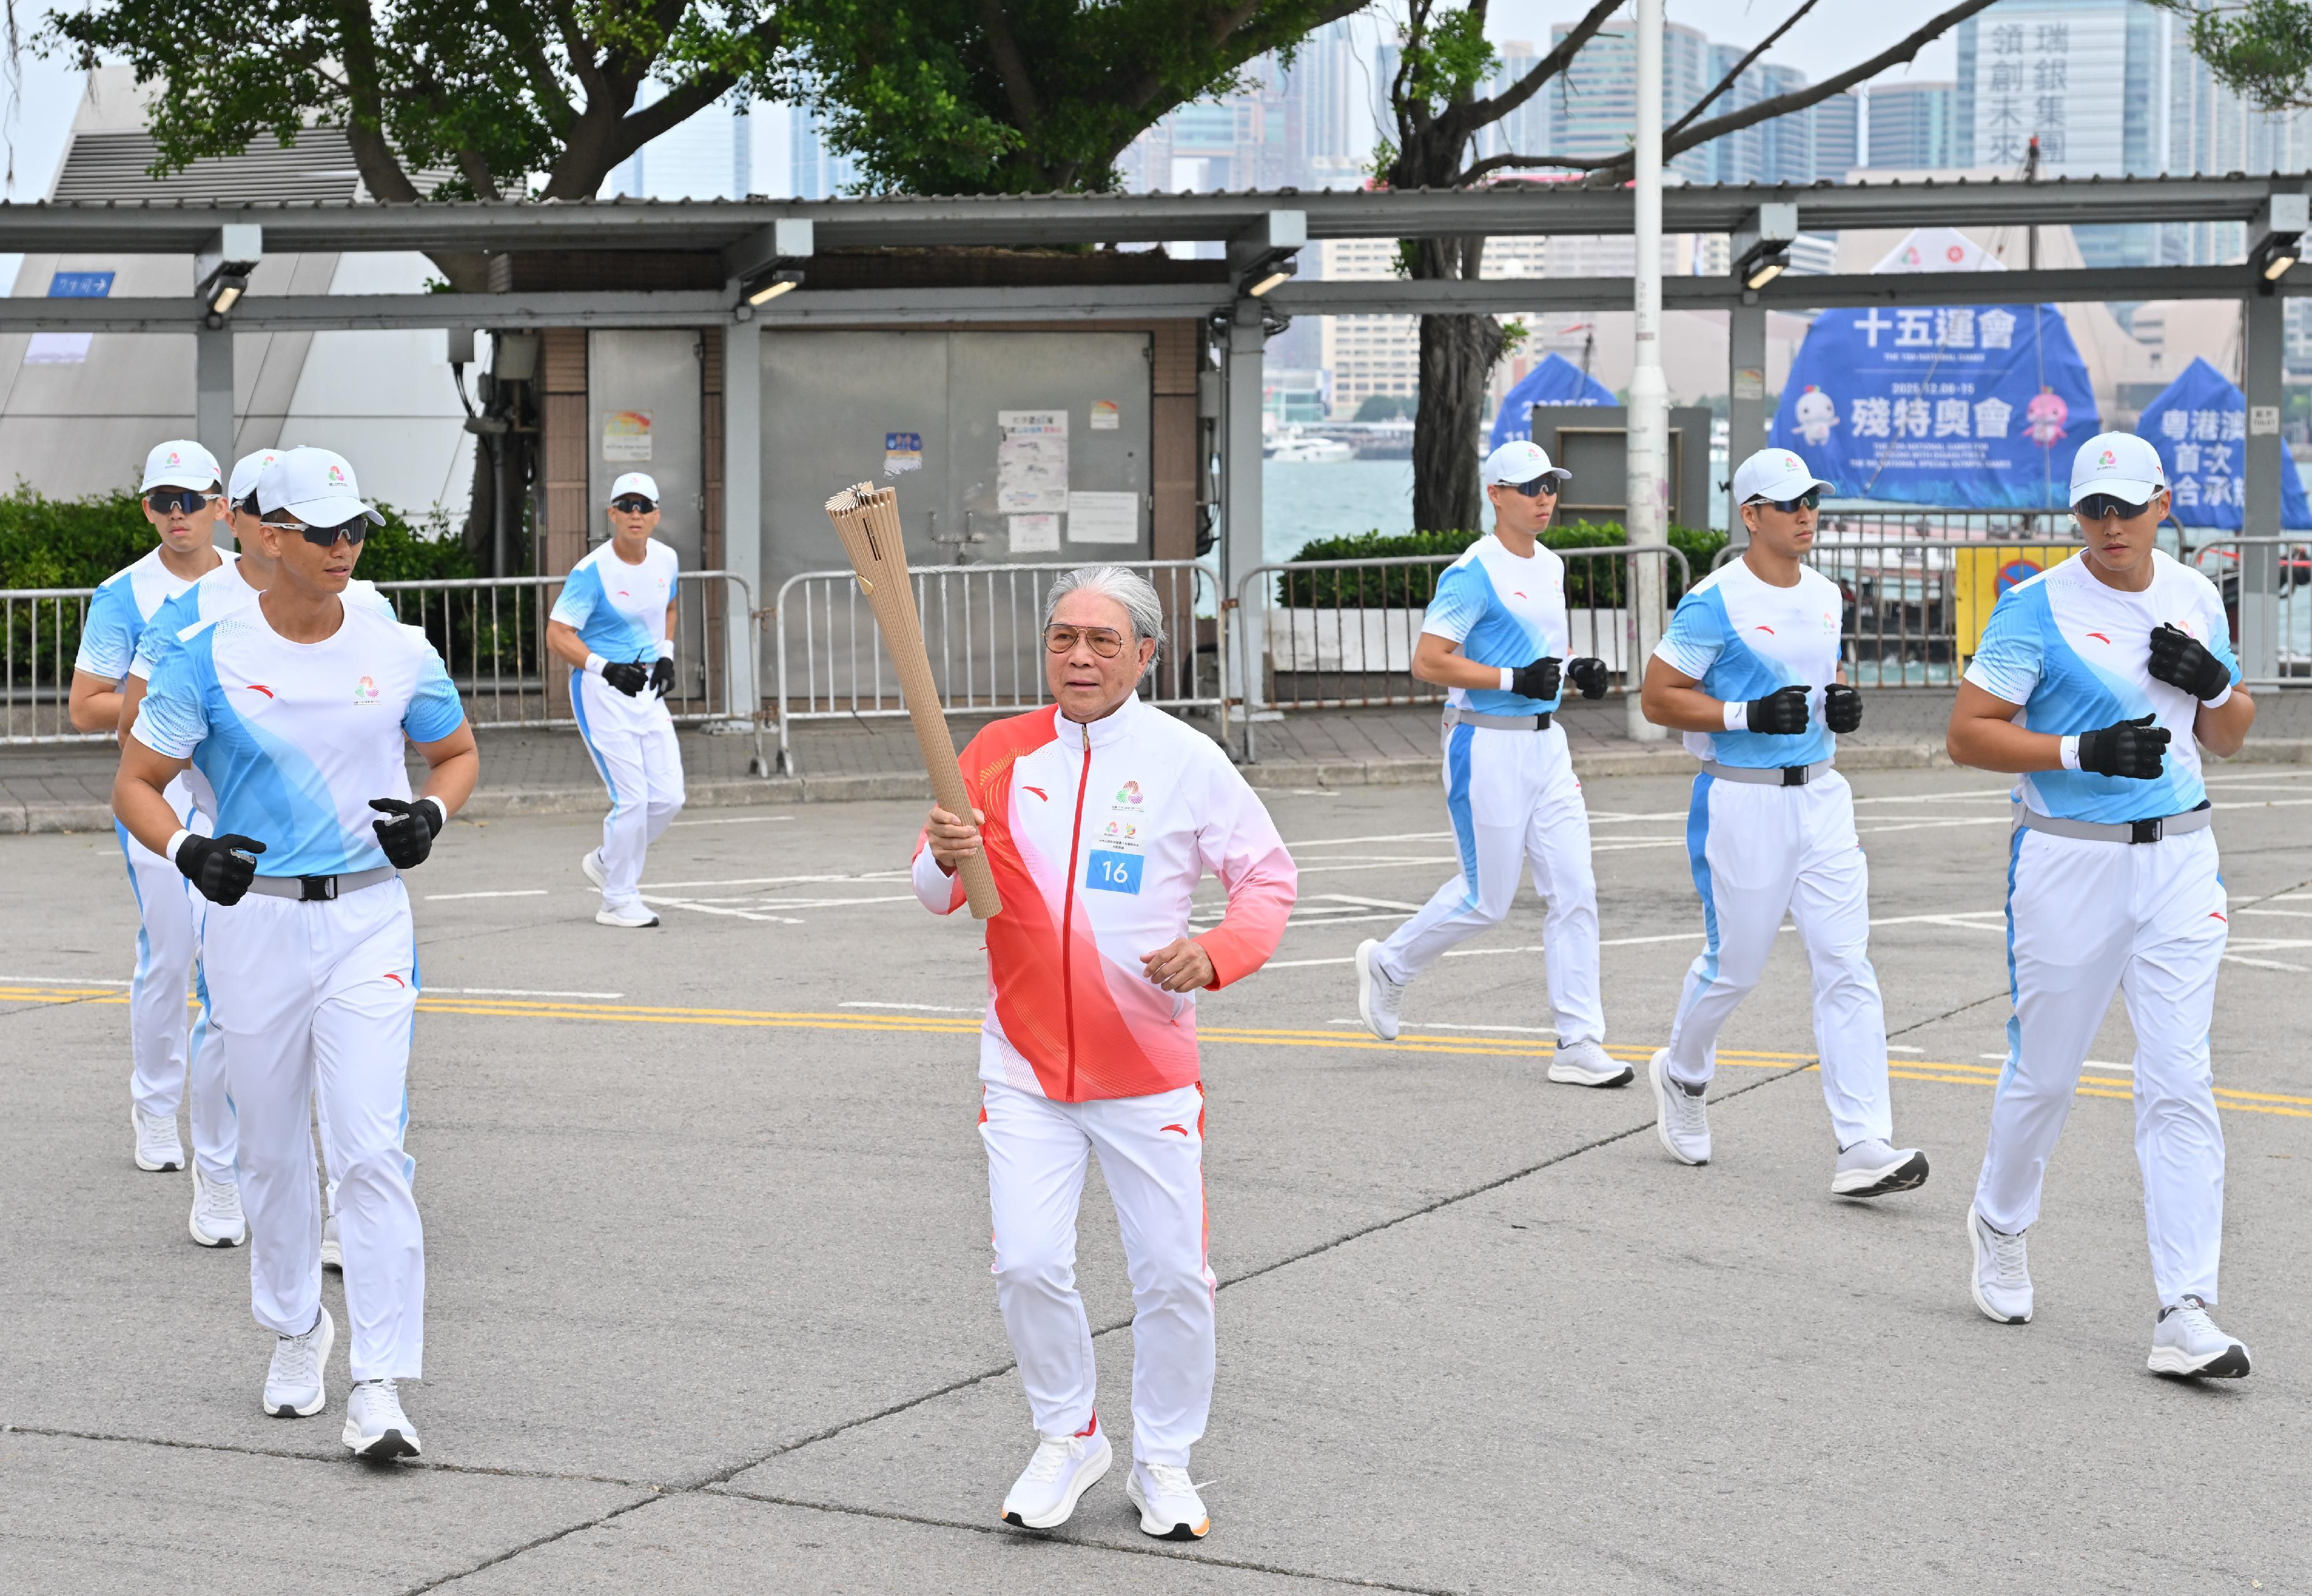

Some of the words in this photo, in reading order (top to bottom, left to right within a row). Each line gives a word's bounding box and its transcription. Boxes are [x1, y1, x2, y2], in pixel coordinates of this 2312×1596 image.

[1853, 308, 2017, 349] 十五運會
[1851, 397, 2013, 438] 殘特奧會
[2173, 441, 2233, 475] 首次
[1103, 861, 1128, 883] 16
